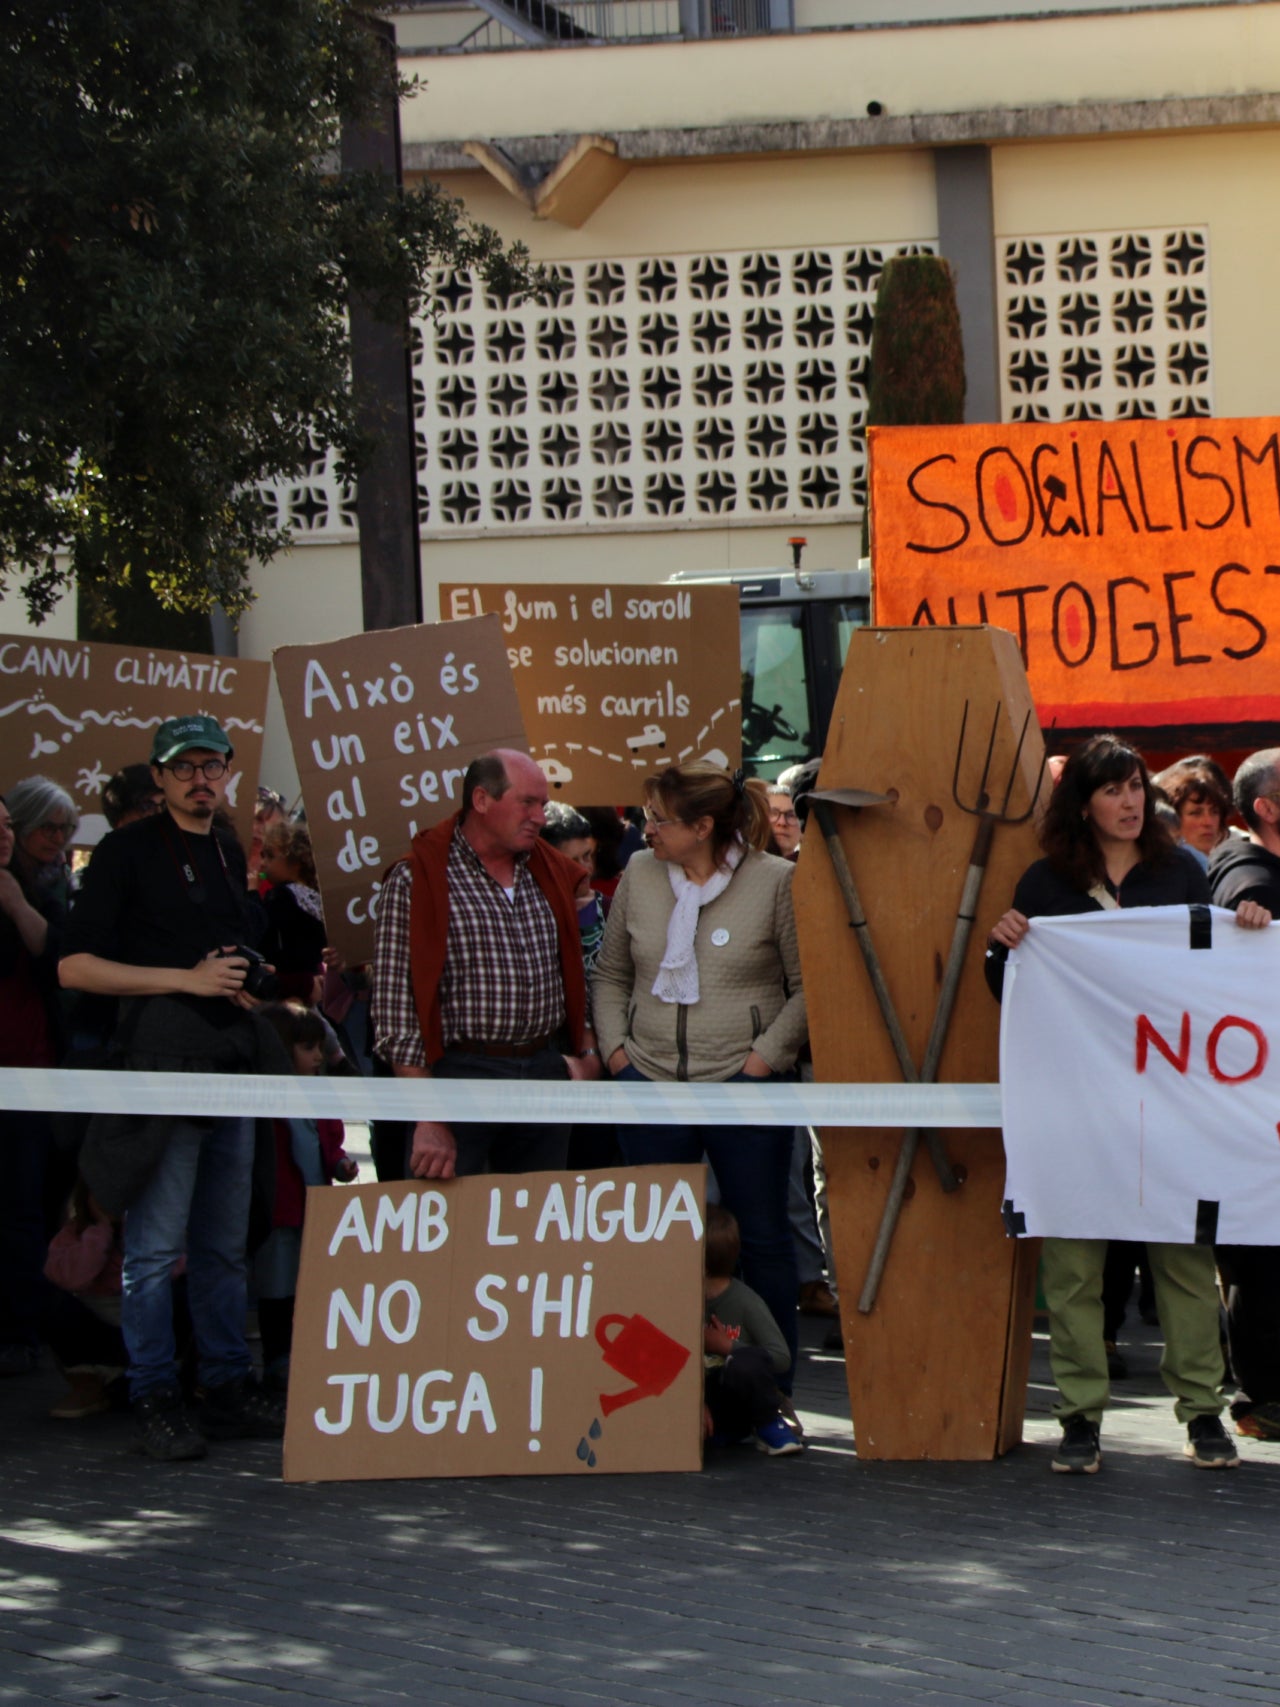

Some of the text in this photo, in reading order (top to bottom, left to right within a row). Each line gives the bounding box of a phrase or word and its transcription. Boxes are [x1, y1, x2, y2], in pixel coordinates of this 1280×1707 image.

[503, 590, 558, 633] fum
[570, 594, 579, 621] i
[592, 588, 613, 619] el
[624, 591, 691, 620] soroll
[507, 638, 679, 669] se solucionen
[304, 652, 480, 719] Això és
[537, 680, 690, 717] més carrils
[312, 713, 460, 770] un eix
[327, 776, 367, 821] al
[336, 829, 381, 873] de
[1135, 1010, 1269, 1087] NO
[328, 1190, 449, 1256] AMB
[326, 1279, 421, 1350] NO
[314, 1369, 498, 1436] JUGA
